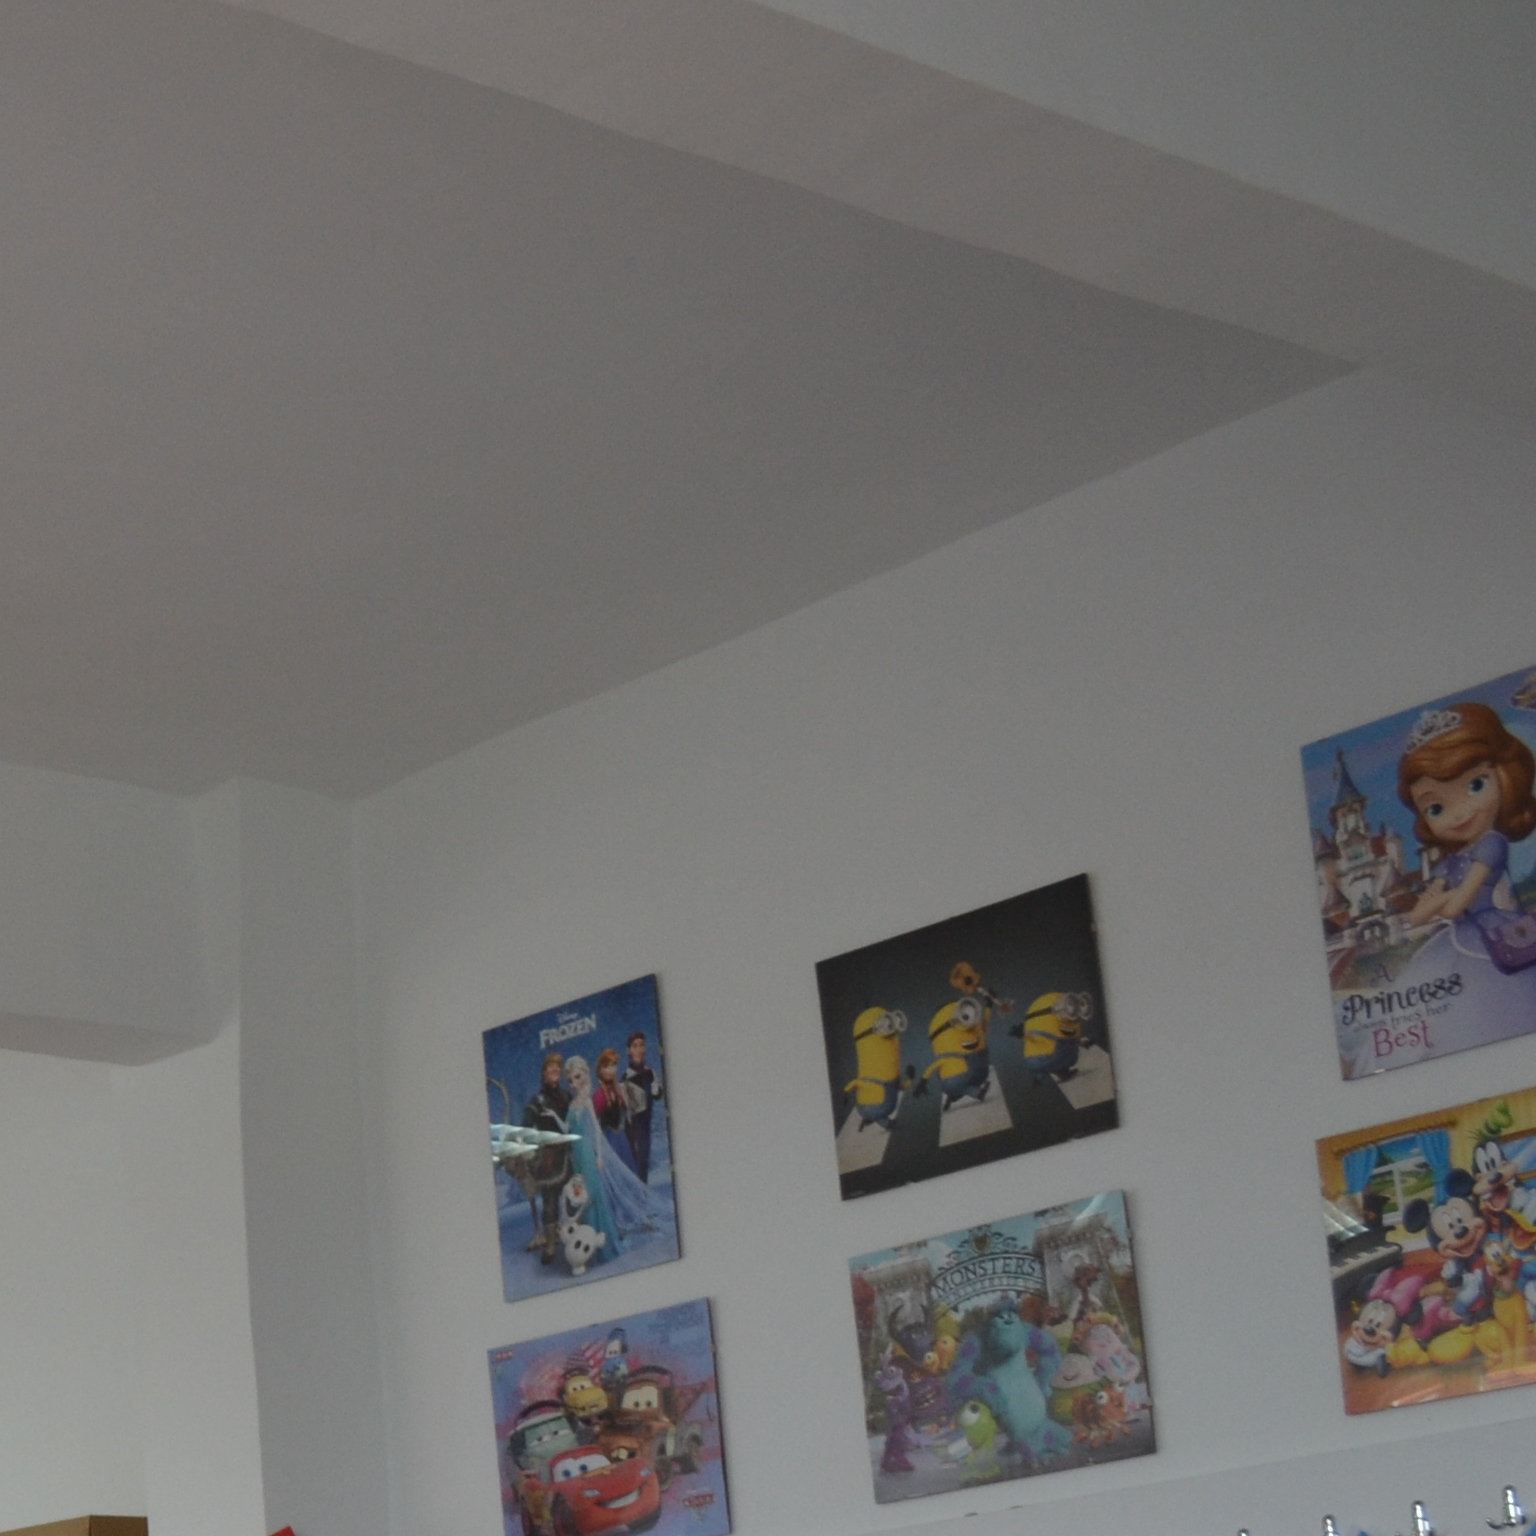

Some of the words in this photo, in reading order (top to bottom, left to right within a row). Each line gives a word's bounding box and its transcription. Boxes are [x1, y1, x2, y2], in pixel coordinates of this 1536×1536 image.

[1342, 973, 1463, 1026] Princess
[539, 1013, 596, 1050] FROZEN
[1372, 1020, 1434, 1058] Best
[929, 1257, 1036, 1298] MONSTERS
